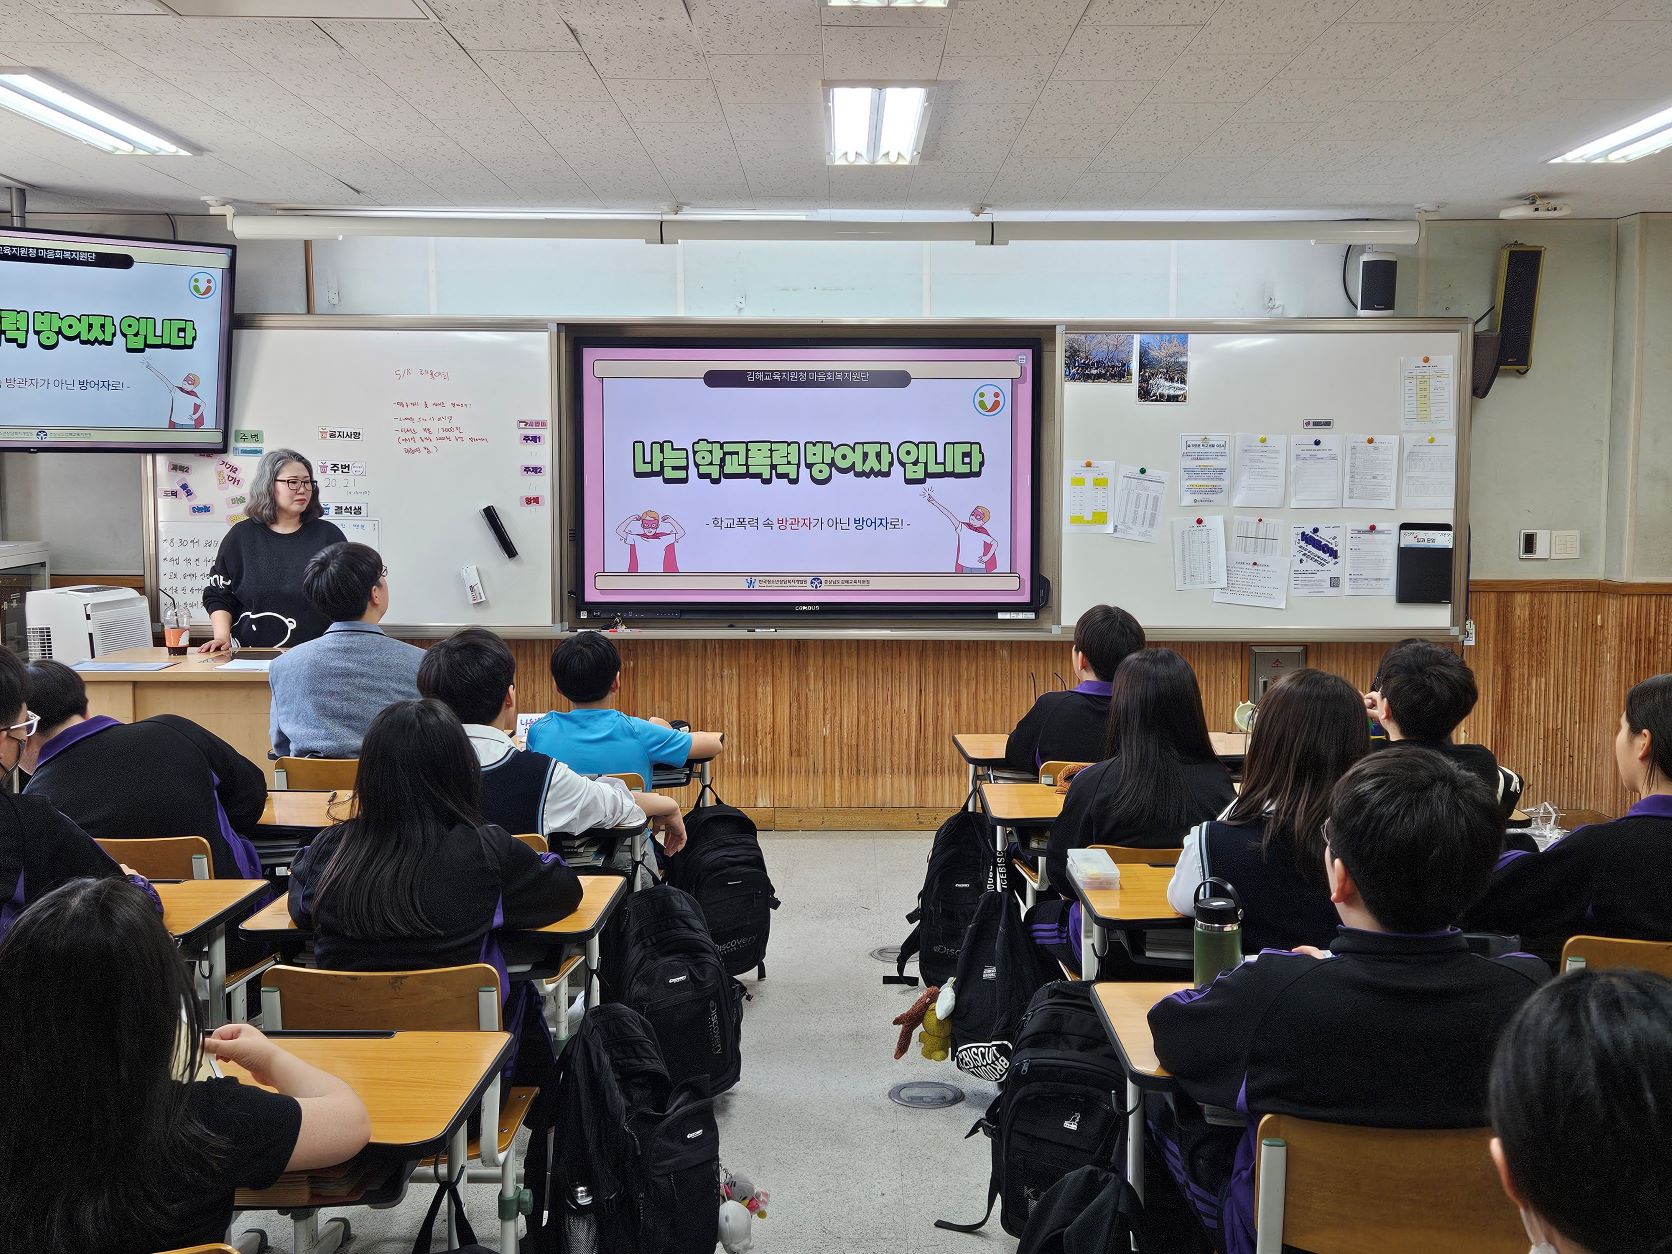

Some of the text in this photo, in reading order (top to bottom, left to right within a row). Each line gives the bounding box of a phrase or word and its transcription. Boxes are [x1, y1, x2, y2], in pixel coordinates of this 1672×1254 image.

[38, 248, 97, 262] 마음회복지원단
[33, 311, 116, 351] 방어자
[120, 315, 197, 354] 입니다
[746, 371, 870, 382] 김해교육지원청 마음회복지원단
[6, 378, 52, 389] 방관자가
[53, 380, 75, 391] 아닌
[79, 380, 124, 392] 방어자로!
[329, 430, 361, 440] 공지사항
[329, 463, 350, 474] 주번
[633, 439, 985, 485] 나는 학교폭력 방어자 입니다
[334, 505, 362, 515] 결석생
[712, 517, 760, 531] 학교폭력
[763, 517, 774, 531] 속
[777, 517, 824, 531] 방관자가
[826, 517, 851, 531] 아닌
[853, 517, 904, 531] 방어자로!
[997, 849, 1008, 889] ICEBISC
